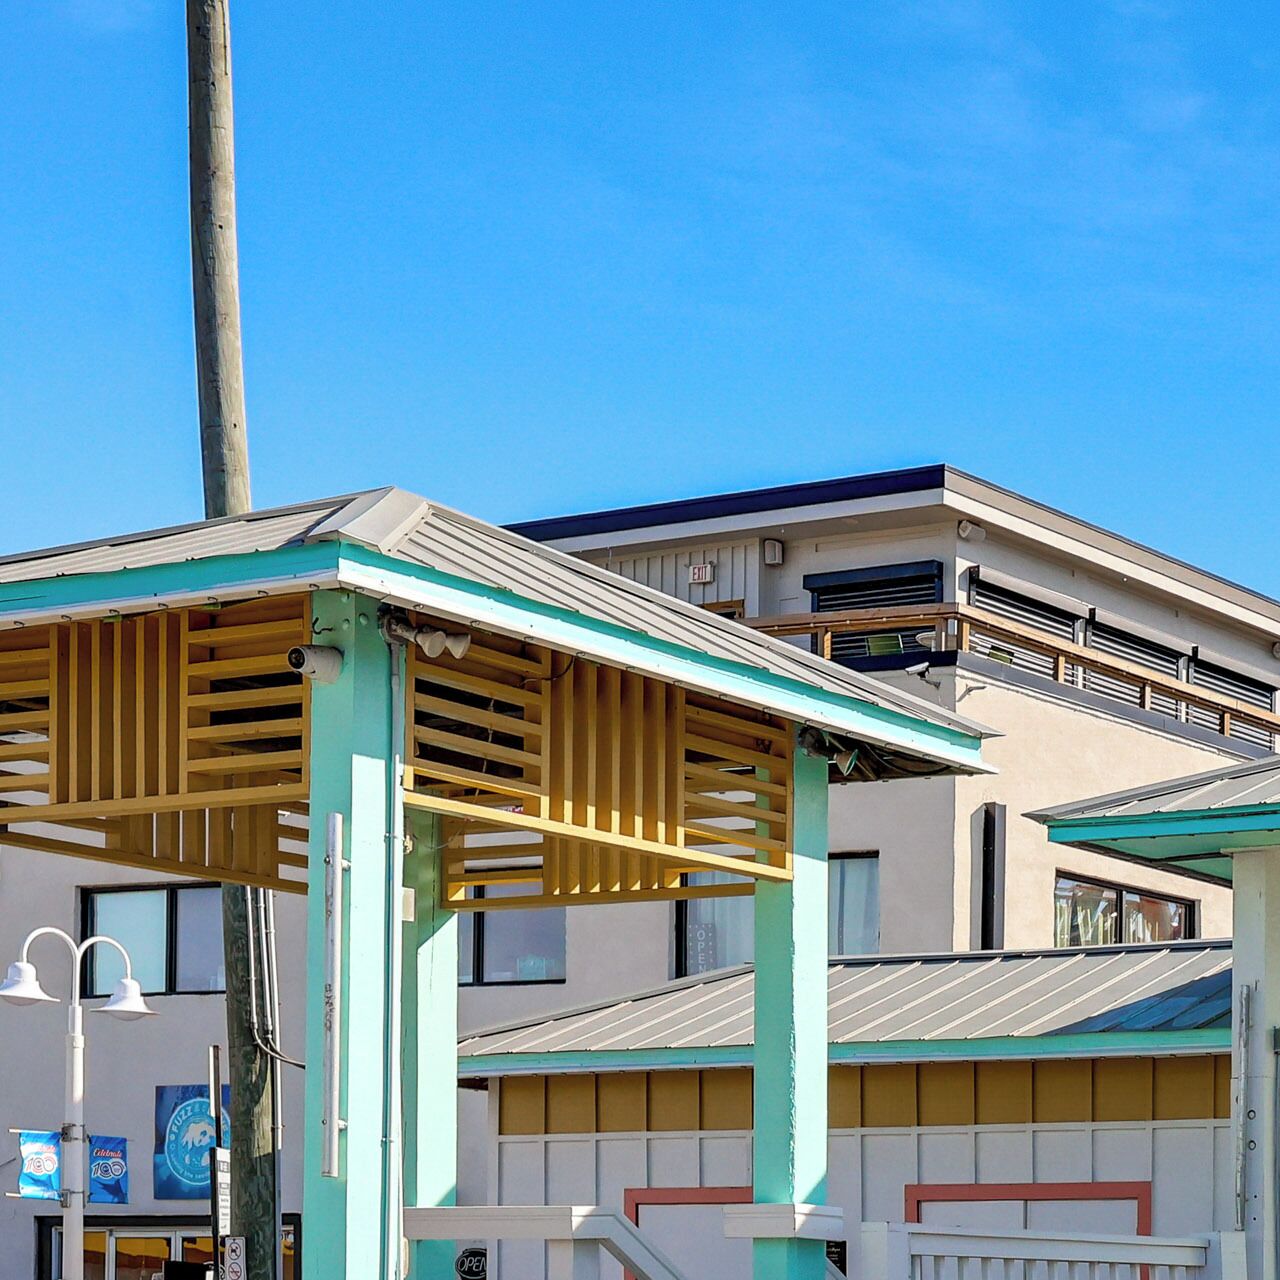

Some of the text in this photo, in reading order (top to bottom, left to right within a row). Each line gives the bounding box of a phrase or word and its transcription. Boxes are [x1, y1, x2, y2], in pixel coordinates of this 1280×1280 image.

[693, 565, 708, 581] EXIT
[697, 930, 706, 973] OPEN
[171, 1105, 193, 1133] FUZZ
[93, 1148, 122, 1158] Celebrate
[458, 1257, 486, 1271] OPEN
